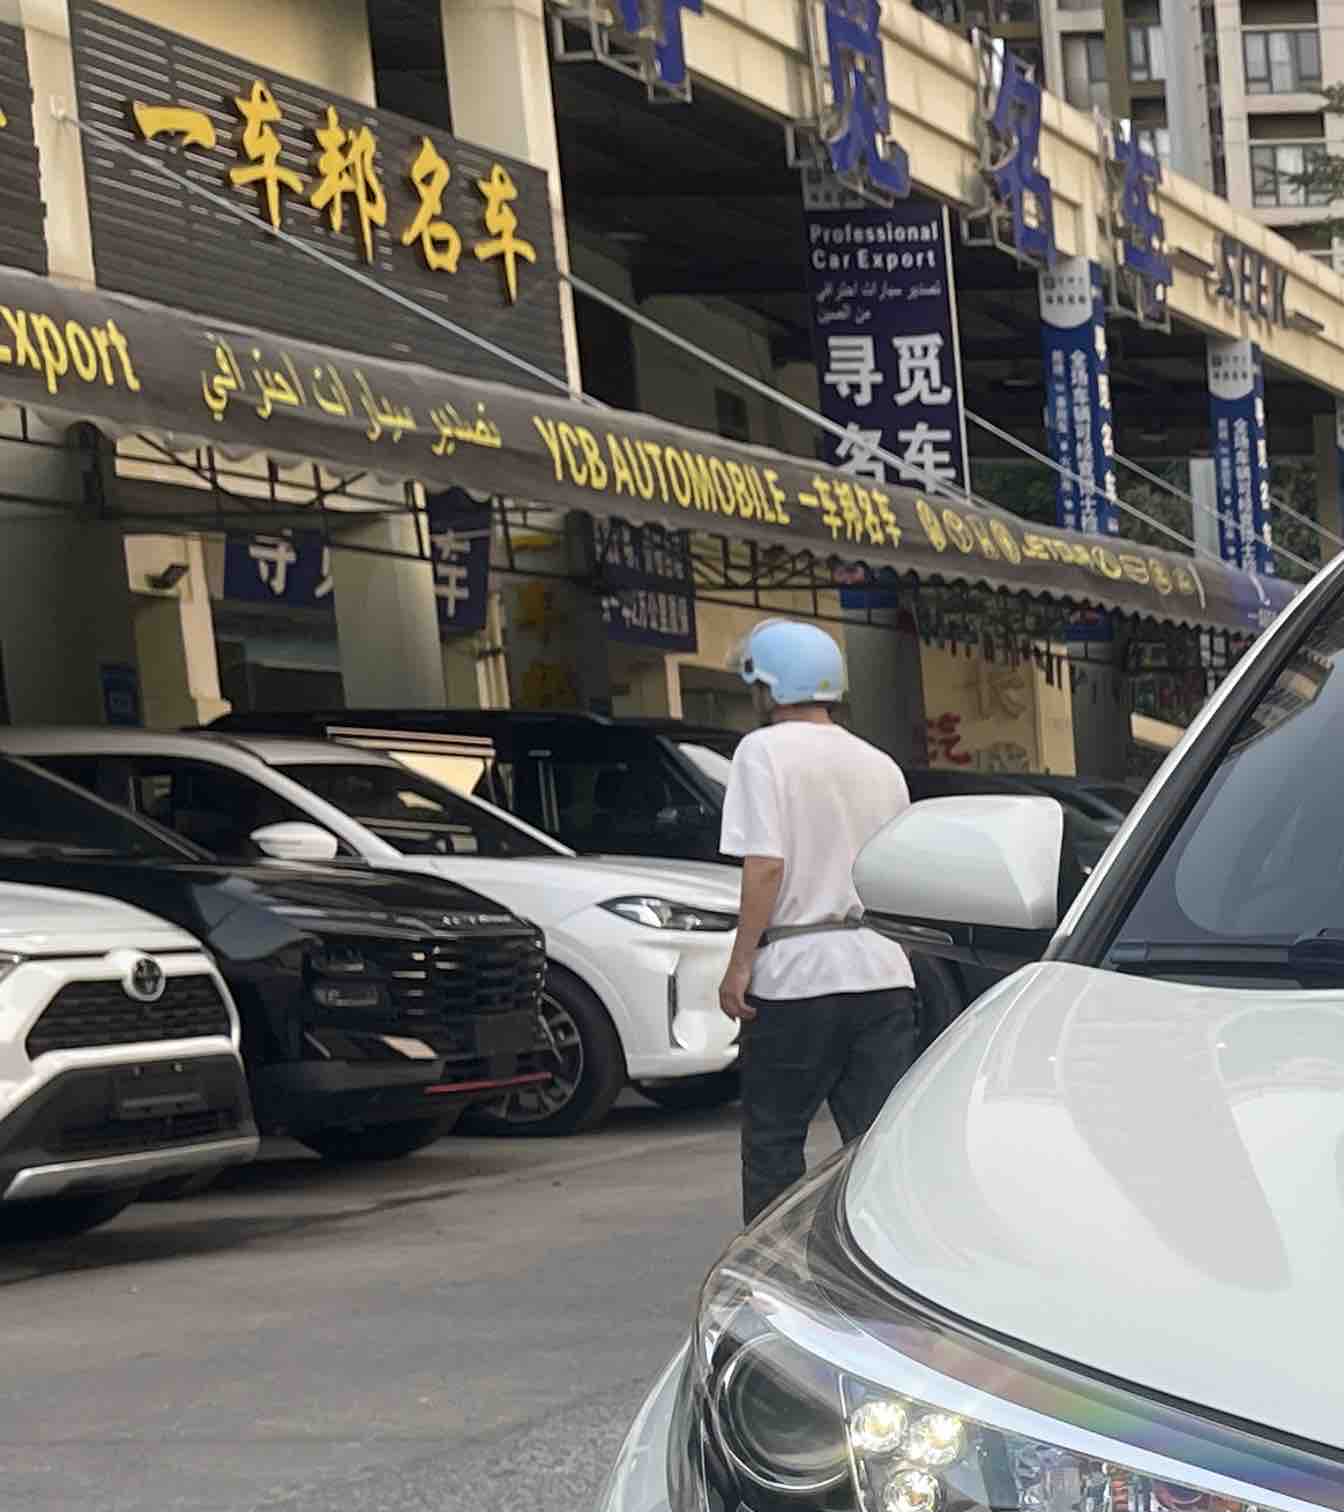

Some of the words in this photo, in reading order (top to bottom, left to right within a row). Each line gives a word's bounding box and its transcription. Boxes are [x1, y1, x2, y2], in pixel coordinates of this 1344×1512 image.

[133, 79, 536, 305] 一车邦名车
[808, 220, 939, 245] Professional
[812, 248, 851, 270] Car
[857, 248, 937, 273] Export
[0, 303, 141, 395] xport
[823, 331, 953, 406] 寻觅
[532, 415, 607, 490] YCB
[606, 432, 791, 525] AUTOMOBILE
